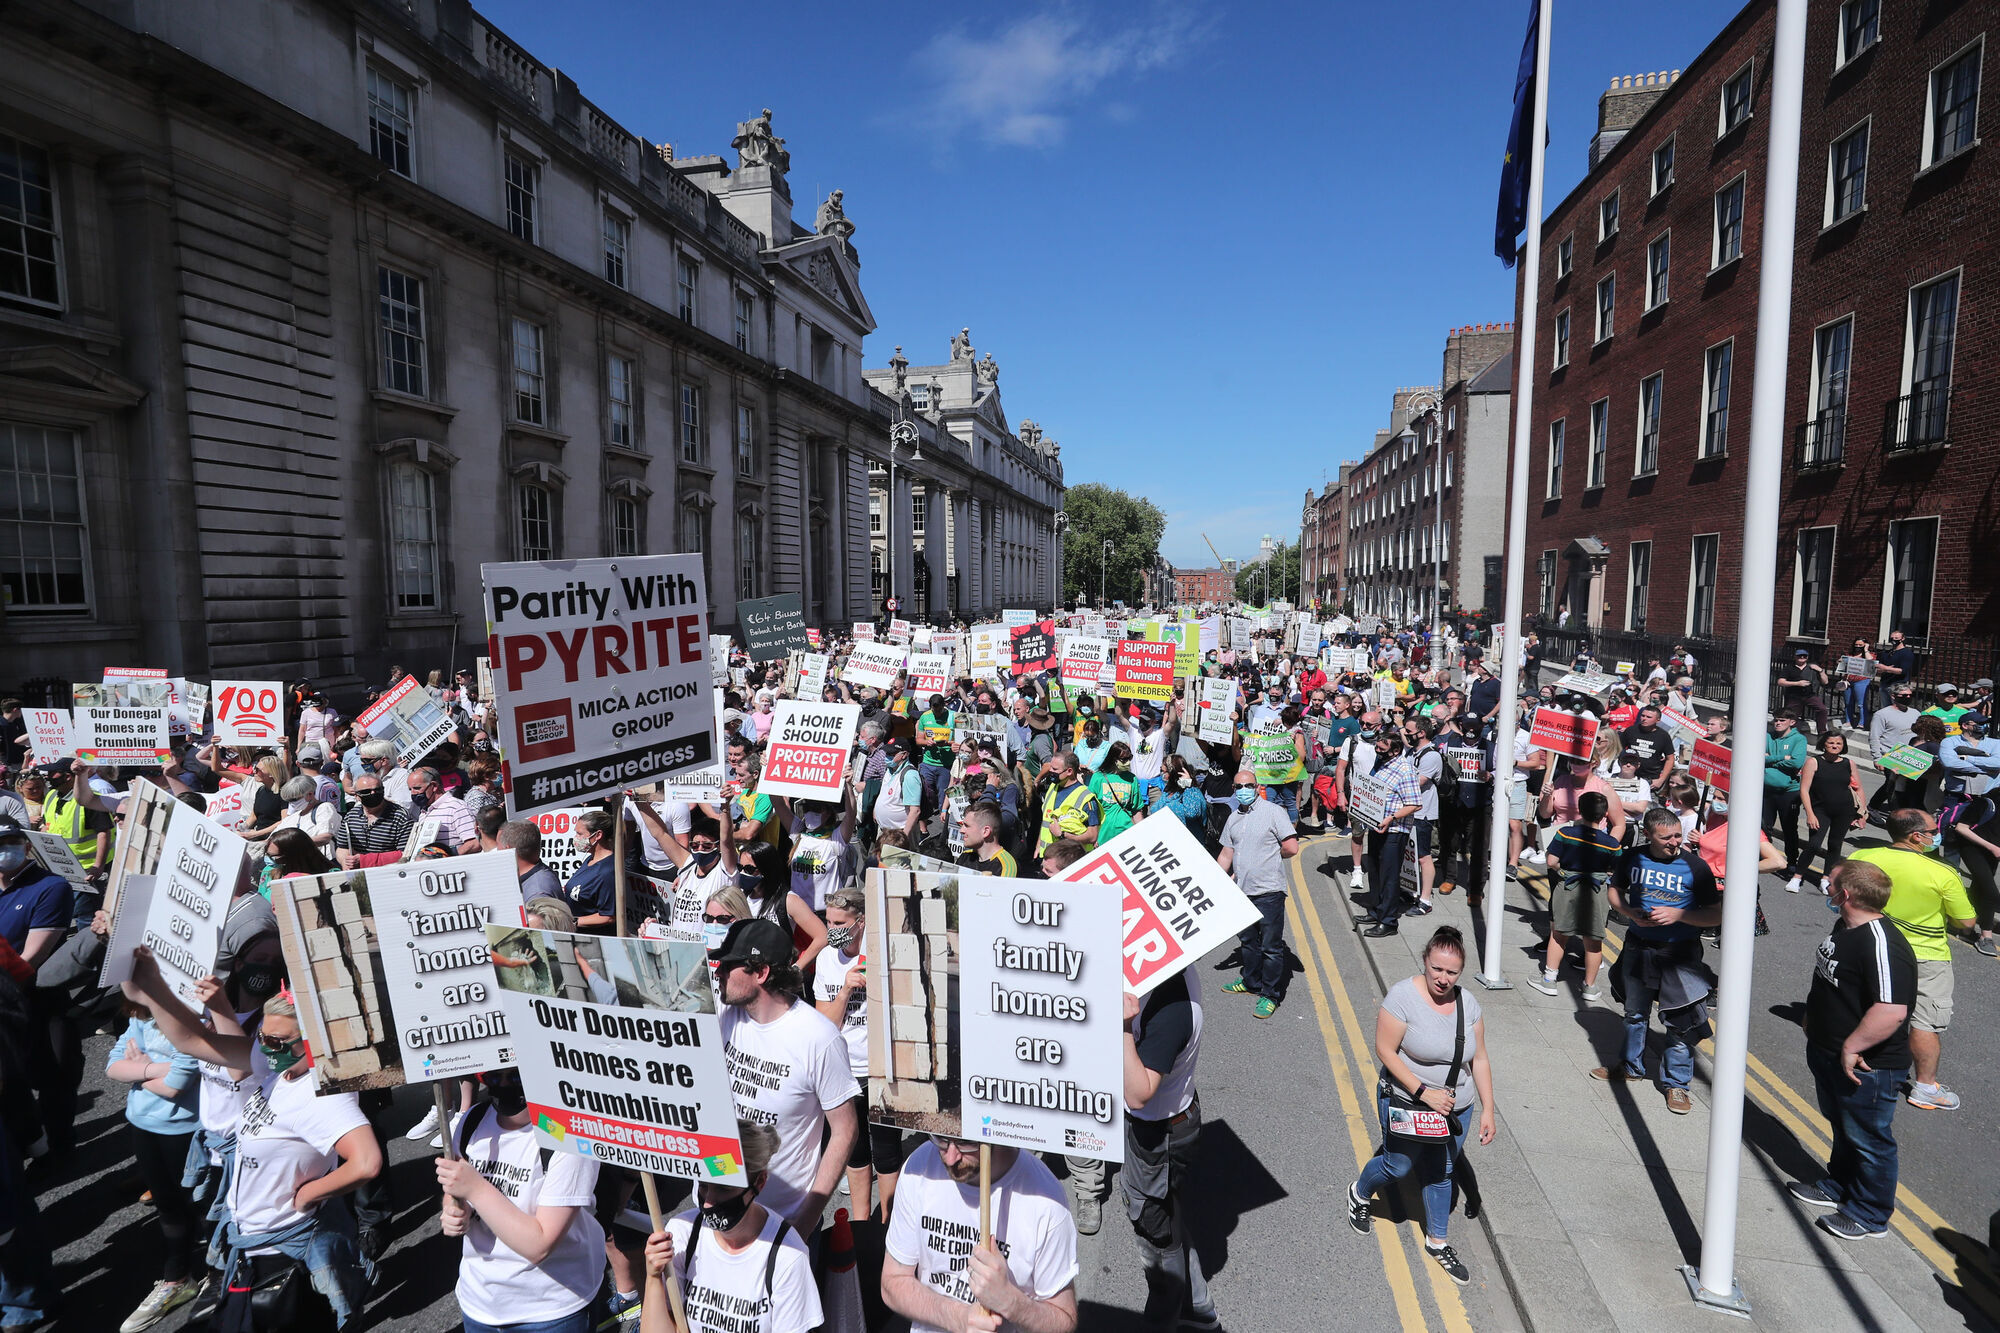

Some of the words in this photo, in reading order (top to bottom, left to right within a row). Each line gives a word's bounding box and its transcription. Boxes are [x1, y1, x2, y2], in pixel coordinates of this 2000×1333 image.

[492, 581, 610, 622] Parity
[621, 573, 697, 610] With
[893, 620, 908, 628] 100%
[504, 615, 702, 692] PYRITE
[1020, 647, 1046, 660] FEAR
[1124, 642, 1168, 655] SUPPORT
[848, 660, 897, 676] CRUMBLING
[852, 651, 864, 660] MY
[866, 654, 888, 664] HOME
[892, 658, 902, 667] IS
[1066, 661, 1100, 670] PROTECT
[1118, 656, 1142, 666] Mica
[1144, 658, 1172, 669] Home
[106, 668, 166, 677] #micaredress
[1072, 670, 1098, 678] FAMILY
[1126, 670, 1162, 681] Owners
[909, 676, 942, 692] FEAR
[1117, 685, 1135, 693] 100%
[1138, 687, 1170, 696] REDRESS
[218, 686, 278, 722] 100
[360, 677, 416, 726] #micaredress
[578, 695, 630, 719] MICA
[635, 682, 698, 708] ACTION
[35, 711, 58, 724] 170
[114, 709, 161, 720] Donegal
[786, 714, 798, 727] A
[800, 714, 843, 730] HOME
[1664, 708, 1708, 736] #micaredress
[35, 726, 55, 735] Cases
[95, 723, 134, 733] Homes
[137, 725, 156, 733] are
[538, 724, 565, 734] ACTION
[612, 712, 674, 738] GROUP
[1533, 729, 1564, 740] AFFECTED
[1536, 719, 1554, 728] 100%
[1556, 723, 1594, 736] REDRESS
[40, 736, 66, 745] PYRITE
[403, 745, 422, 765] 00%
[418, 719, 453, 752] REDRESS
[538, 731, 564, 740] GROUP
[782, 728, 839, 745] SHOULD
[52, 748, 60, 756] in
[775, 749, 839, 766] PROTECT
[1449, 750, 1484, 761] SUPPORT
[532, 745, 695, 801] #micaredress
[770, 767, 782, 777] A
[785, 767, 836, 782] FAMILY
[1354, 785, 1383, 806] HOMELESS
[193, 824, 218, 852] Our
[177, 848, 218, 892] family
[1149, 841, 1180, 874] WE
[1172, 876, 1215, 916] ARE
[419, 870, 466, 898] Our
[1631, 866, 1685, 894] DIESEL
[168, 875, 210, 918] homes
[1119, 846, 1177, 911] LIVING
[1170, 912, 1200, 941] IN
[1012, 892, 1063, 927] Our
[171, 916, 192, 941] are
[408, 904, 490, 937] family
[144, 930, 207, 980] crumbling
[993, 937, 1083, 981] family
[443, 982, 486, 1006] are
[991, 982, 1087, 1022] homes
[582, 1007, 701, 1048] Donegal
[1016, 1036, 1062, 1065] are
[550, 1041, 641, 1081] Homes
[646, 1062, 694, 1088] are
[759, 1059, 790, 1077] HOMES
[735, 1067, 780, 1090] CRUMBLING
[732, 1080, 758, 1100] DOWN
[969, 1074, 1113, 1124] crumbling
[992, 1119, 1034, 1130] @paddydiver4
[1414, 1112, 1445, 1122] 100%
[569, 1116, 700, 1156] #micaredress
[992, 1130, 1046, 1144] 100%redressnoless
[1076, 1130, 1095, 1139] MICA
[1076, 1137, 1106, 1146] ACTION
[1076, 1143, 1103, 1152] GROUP
[593, 1142, 702, 1178] @PADDYDIVER4
[922, 1215, 942, 1232] OUR
[928, 1234, 946, 1254] ARE
[700, 1287, 733, 1312] FAMILY
[734, 1296, 769, 1318] HOMES
[700, 1308, 760, 1333] CRUMBLING
